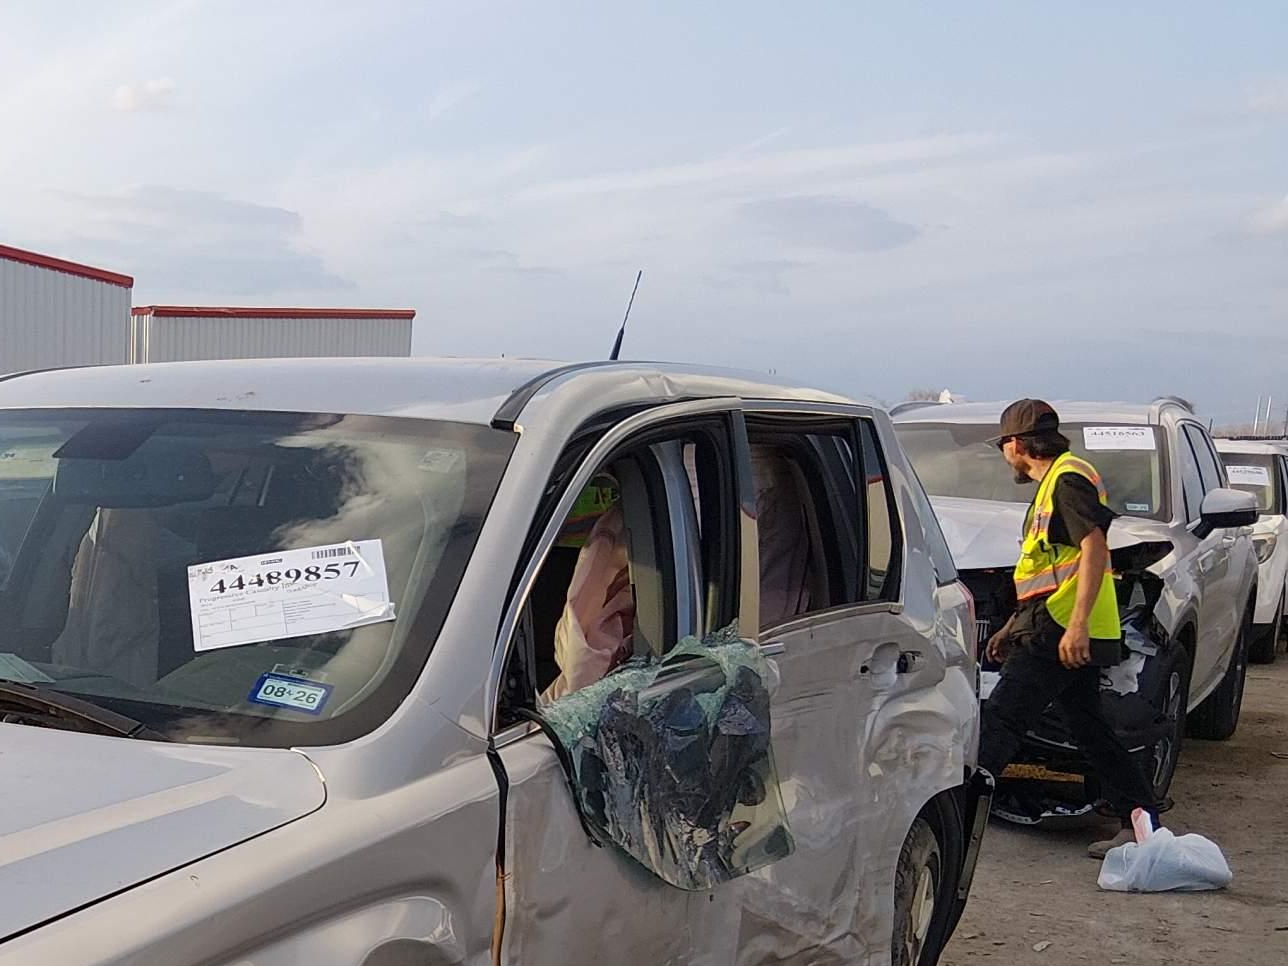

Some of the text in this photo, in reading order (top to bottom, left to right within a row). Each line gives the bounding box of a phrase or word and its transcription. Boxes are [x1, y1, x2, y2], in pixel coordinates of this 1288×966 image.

[209, 560, 361, 594] 44489857
[262, 684, 319, 704] 08 26
